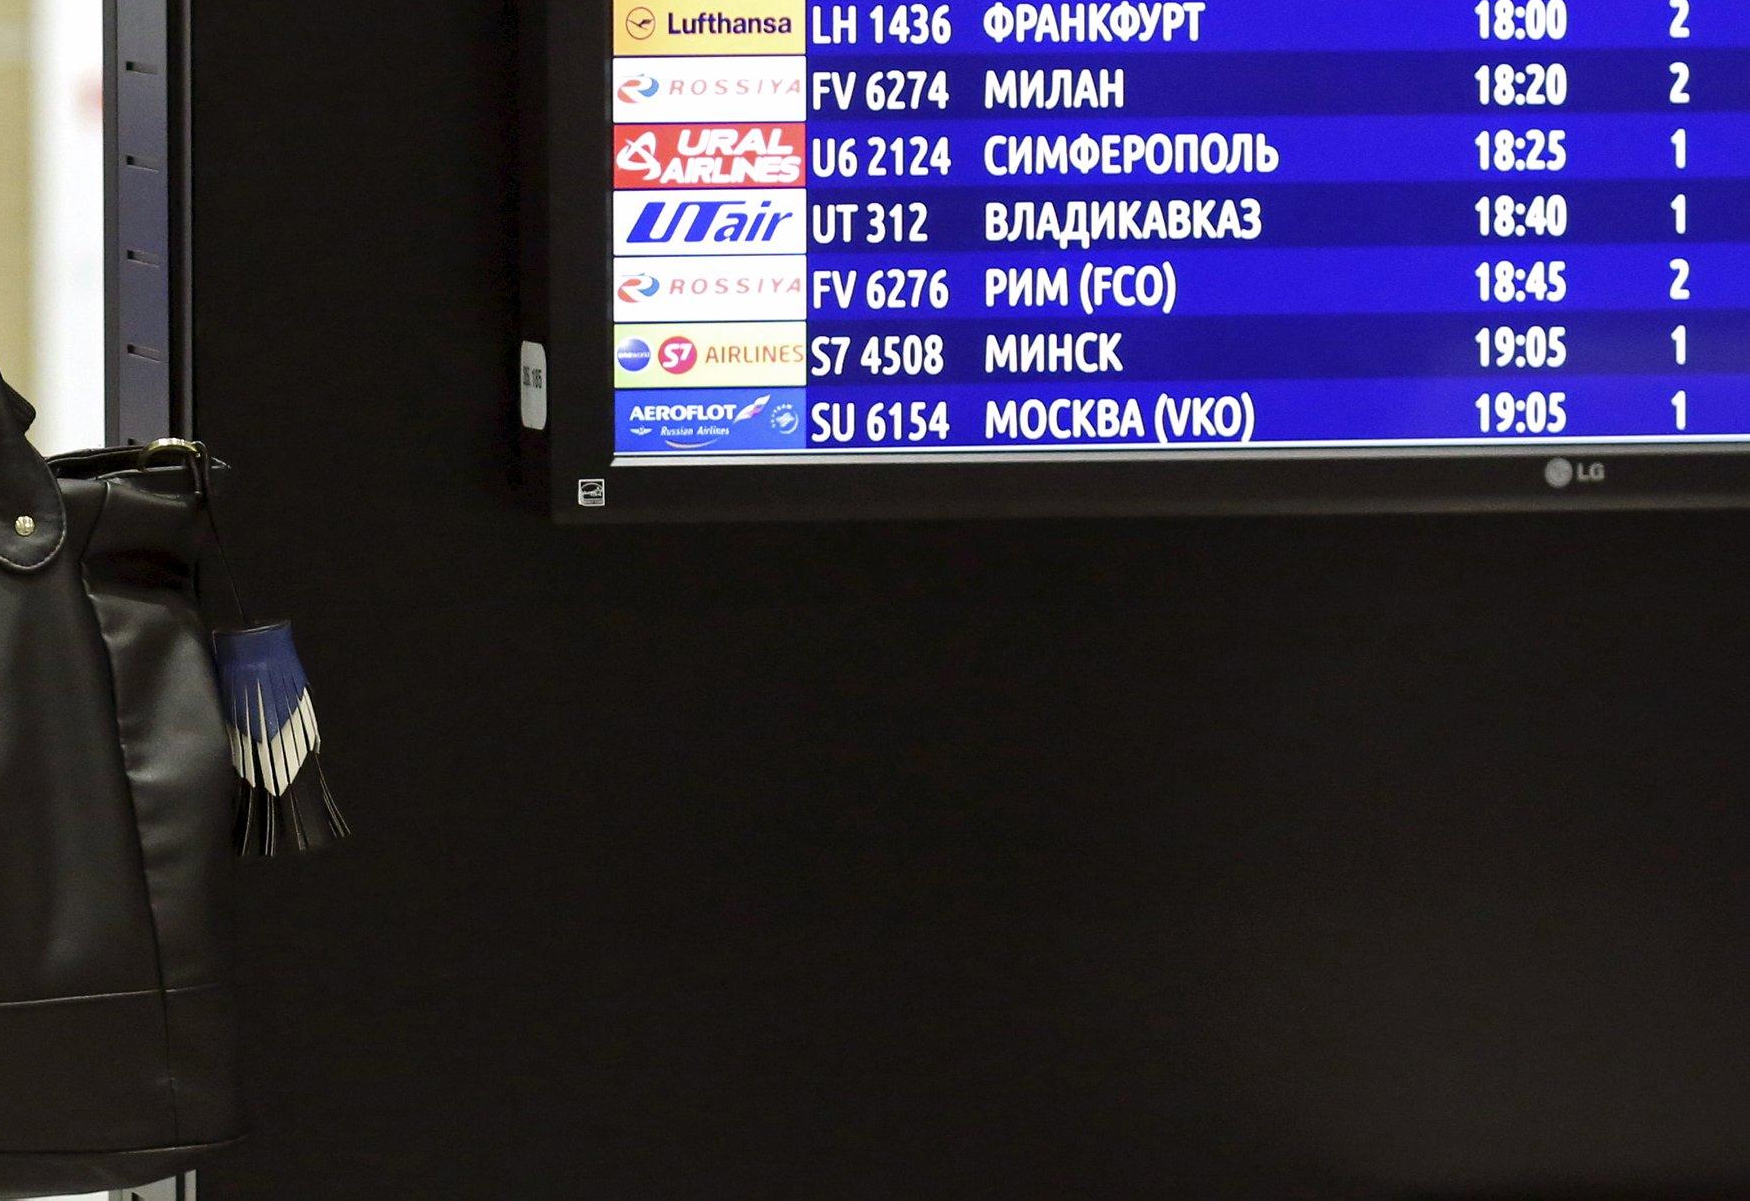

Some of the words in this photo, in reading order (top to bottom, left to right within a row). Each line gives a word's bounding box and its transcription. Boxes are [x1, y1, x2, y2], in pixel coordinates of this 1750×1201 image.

[667, 11, 792, 35] Lufthansa
[812, 5, 857, 44] LH
[869, 3, 952, 45] 1436
[983, 0, 1206, 43] ФРАНКФУРТ
[668, 78, 801, 96] ROSSIYA
[812, 71, 857, 111] FV
[865, 70, 950, 111] 6274
[984, 68, 1124, 110] МИЛАН
[1474, 63, 1568, 106] 18:20
[1669, 61, 1690, 104] 2
[677, 127, 794, 157] URAL
[812, 137, 858, 178] U6
[867, 135, 952, 176] 2124
[984, 132, 1279, 176] СИМФЕРОПОЛЬ
[1474, 129, 1567, 172] 18:25
[1670, 128, 1686, 169] 1
[659, 155, 802, 184] AIRLINES
[626, 200, 793, 243] UTair
[812, 204, 859, 244] UT
[866, 202, 928, 244] 312
[985, 197, 1262, 250] ВЛАДИКАВКАЗ
[1474, 194, 1568, 237] 18:40
[1670, 193, 1686, 234] 1
[668, 278, 802, 295] ROSSIYA
[813, 270, 857, 309] FV
[866, 268, 949, 310] 6276
[985, 267, 1069, 307] РИМ
[1079, 261, 1177, 315] (FCO)
[1475, 260, 1567, 303] 18:45
[1669, 258, 1690, 300] 2
[662, 342, 693, 369] S7
[705, 344, 805, 364] AIRLINES
[811, 335, 851, 377] S7
[860, 334, 944, 376] 4508
[985, 331, 1124, 373] МИНСК
[1475, 325, 1567, 368] 19:05
[1670, 324, 1686, 365] 1
[628, 404, 737, 422] AEROFLOT
[811, 402, 855, 442] SU
[866, 401, 950, 442] 6154
[985, 398, 1145, 440] МОСКВА
[1154, 392, 1255, 443] (VKO)
[1475, 391, 1567, 434] 19:05
[1670, 389, 1686, 431] 1
[659, 426, 693, 437] Russian
[696, 426, 730, 437] Airlines
[1576, 462, 1605, 482] LG
